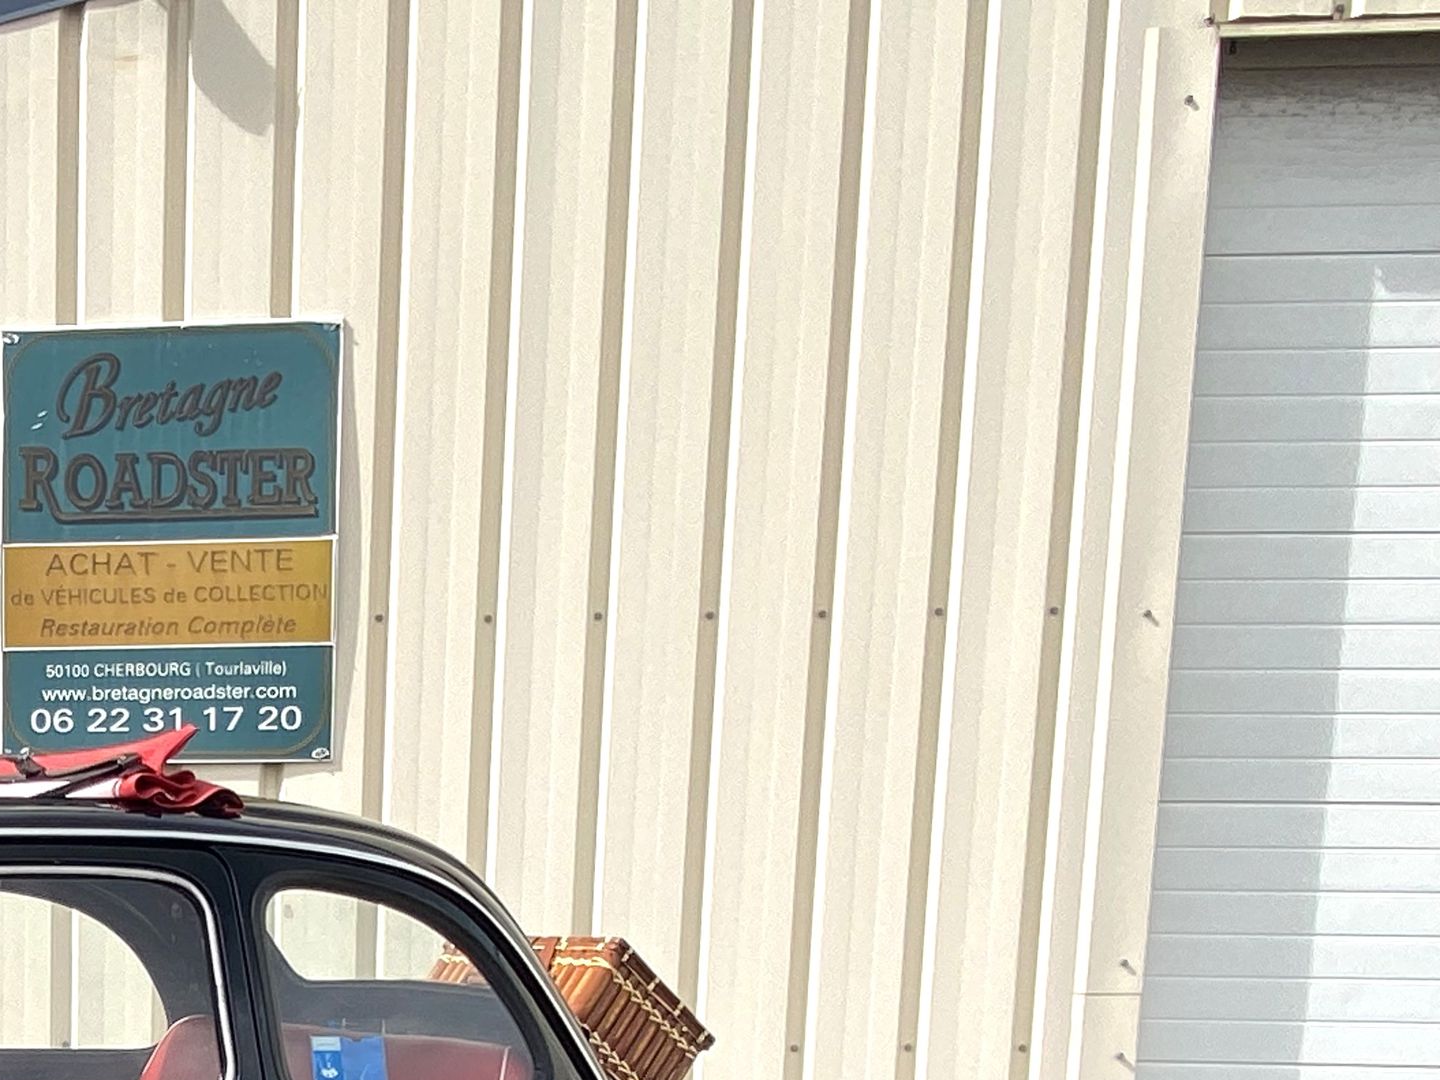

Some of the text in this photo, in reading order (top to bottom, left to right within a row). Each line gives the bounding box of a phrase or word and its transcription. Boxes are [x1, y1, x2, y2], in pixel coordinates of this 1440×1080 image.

[56, 352, 283, 440] Bretagne
[18, 446, 319, 524] ROADSTER
[45, 551, 157, 577] ACHAT
[187, 548, 294, 573] VENTE
[10, 583, 328, 607] de VÉHICULES de COLLECTION
[39, 613, 297, 640] Restauration Complète
[46, 664, 90, 679] 50100
[93, 662, 191, 678] CHERBOURG
[41, 684, 298, 704] www.bretagneroadster.com
[30, 705, 303, 734] 06 22 31 17 20
